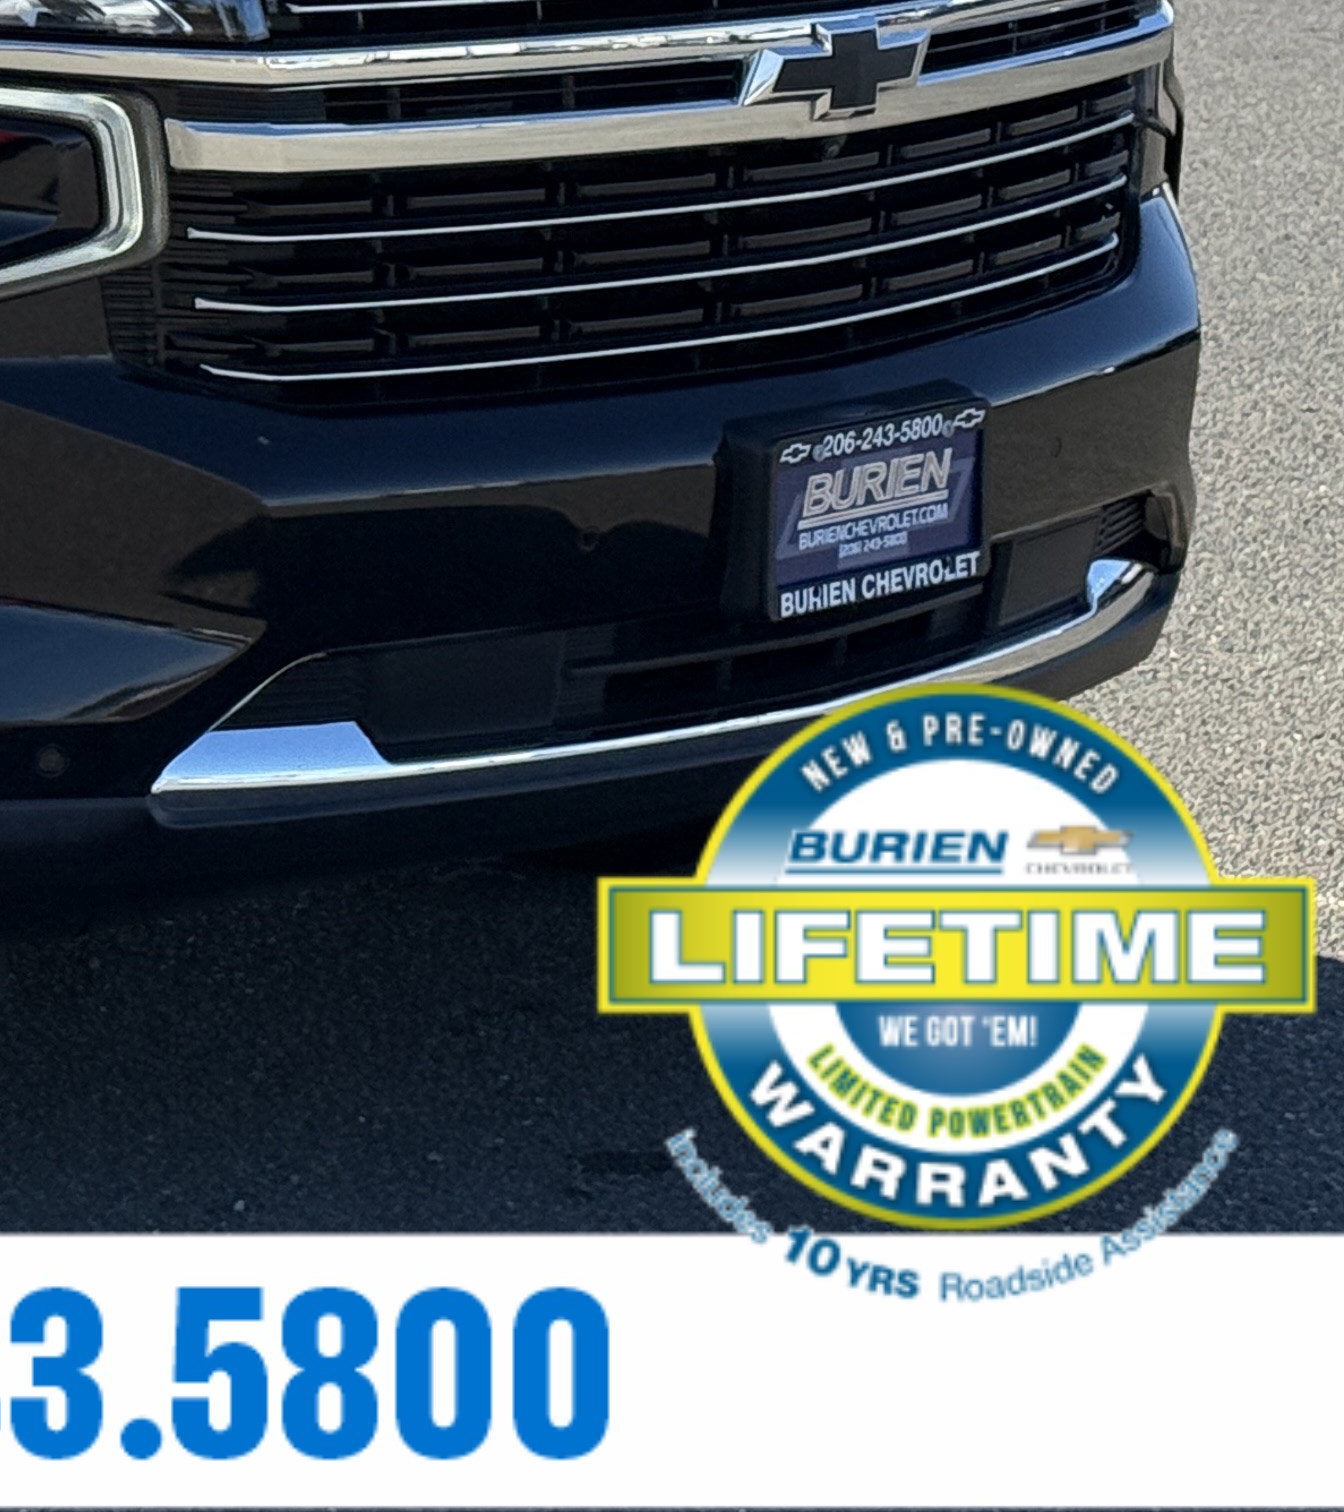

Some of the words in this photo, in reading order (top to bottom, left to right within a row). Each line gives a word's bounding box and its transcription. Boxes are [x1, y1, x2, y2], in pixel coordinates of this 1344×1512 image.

[822, 413, 943, 459] 206-243-5800
[802, 447, 953, 518] BURIEN
[798, 502, 949, 551] BURIENCHEVROLET.COM
[861, 550, 981, 600] CHEVROLET
